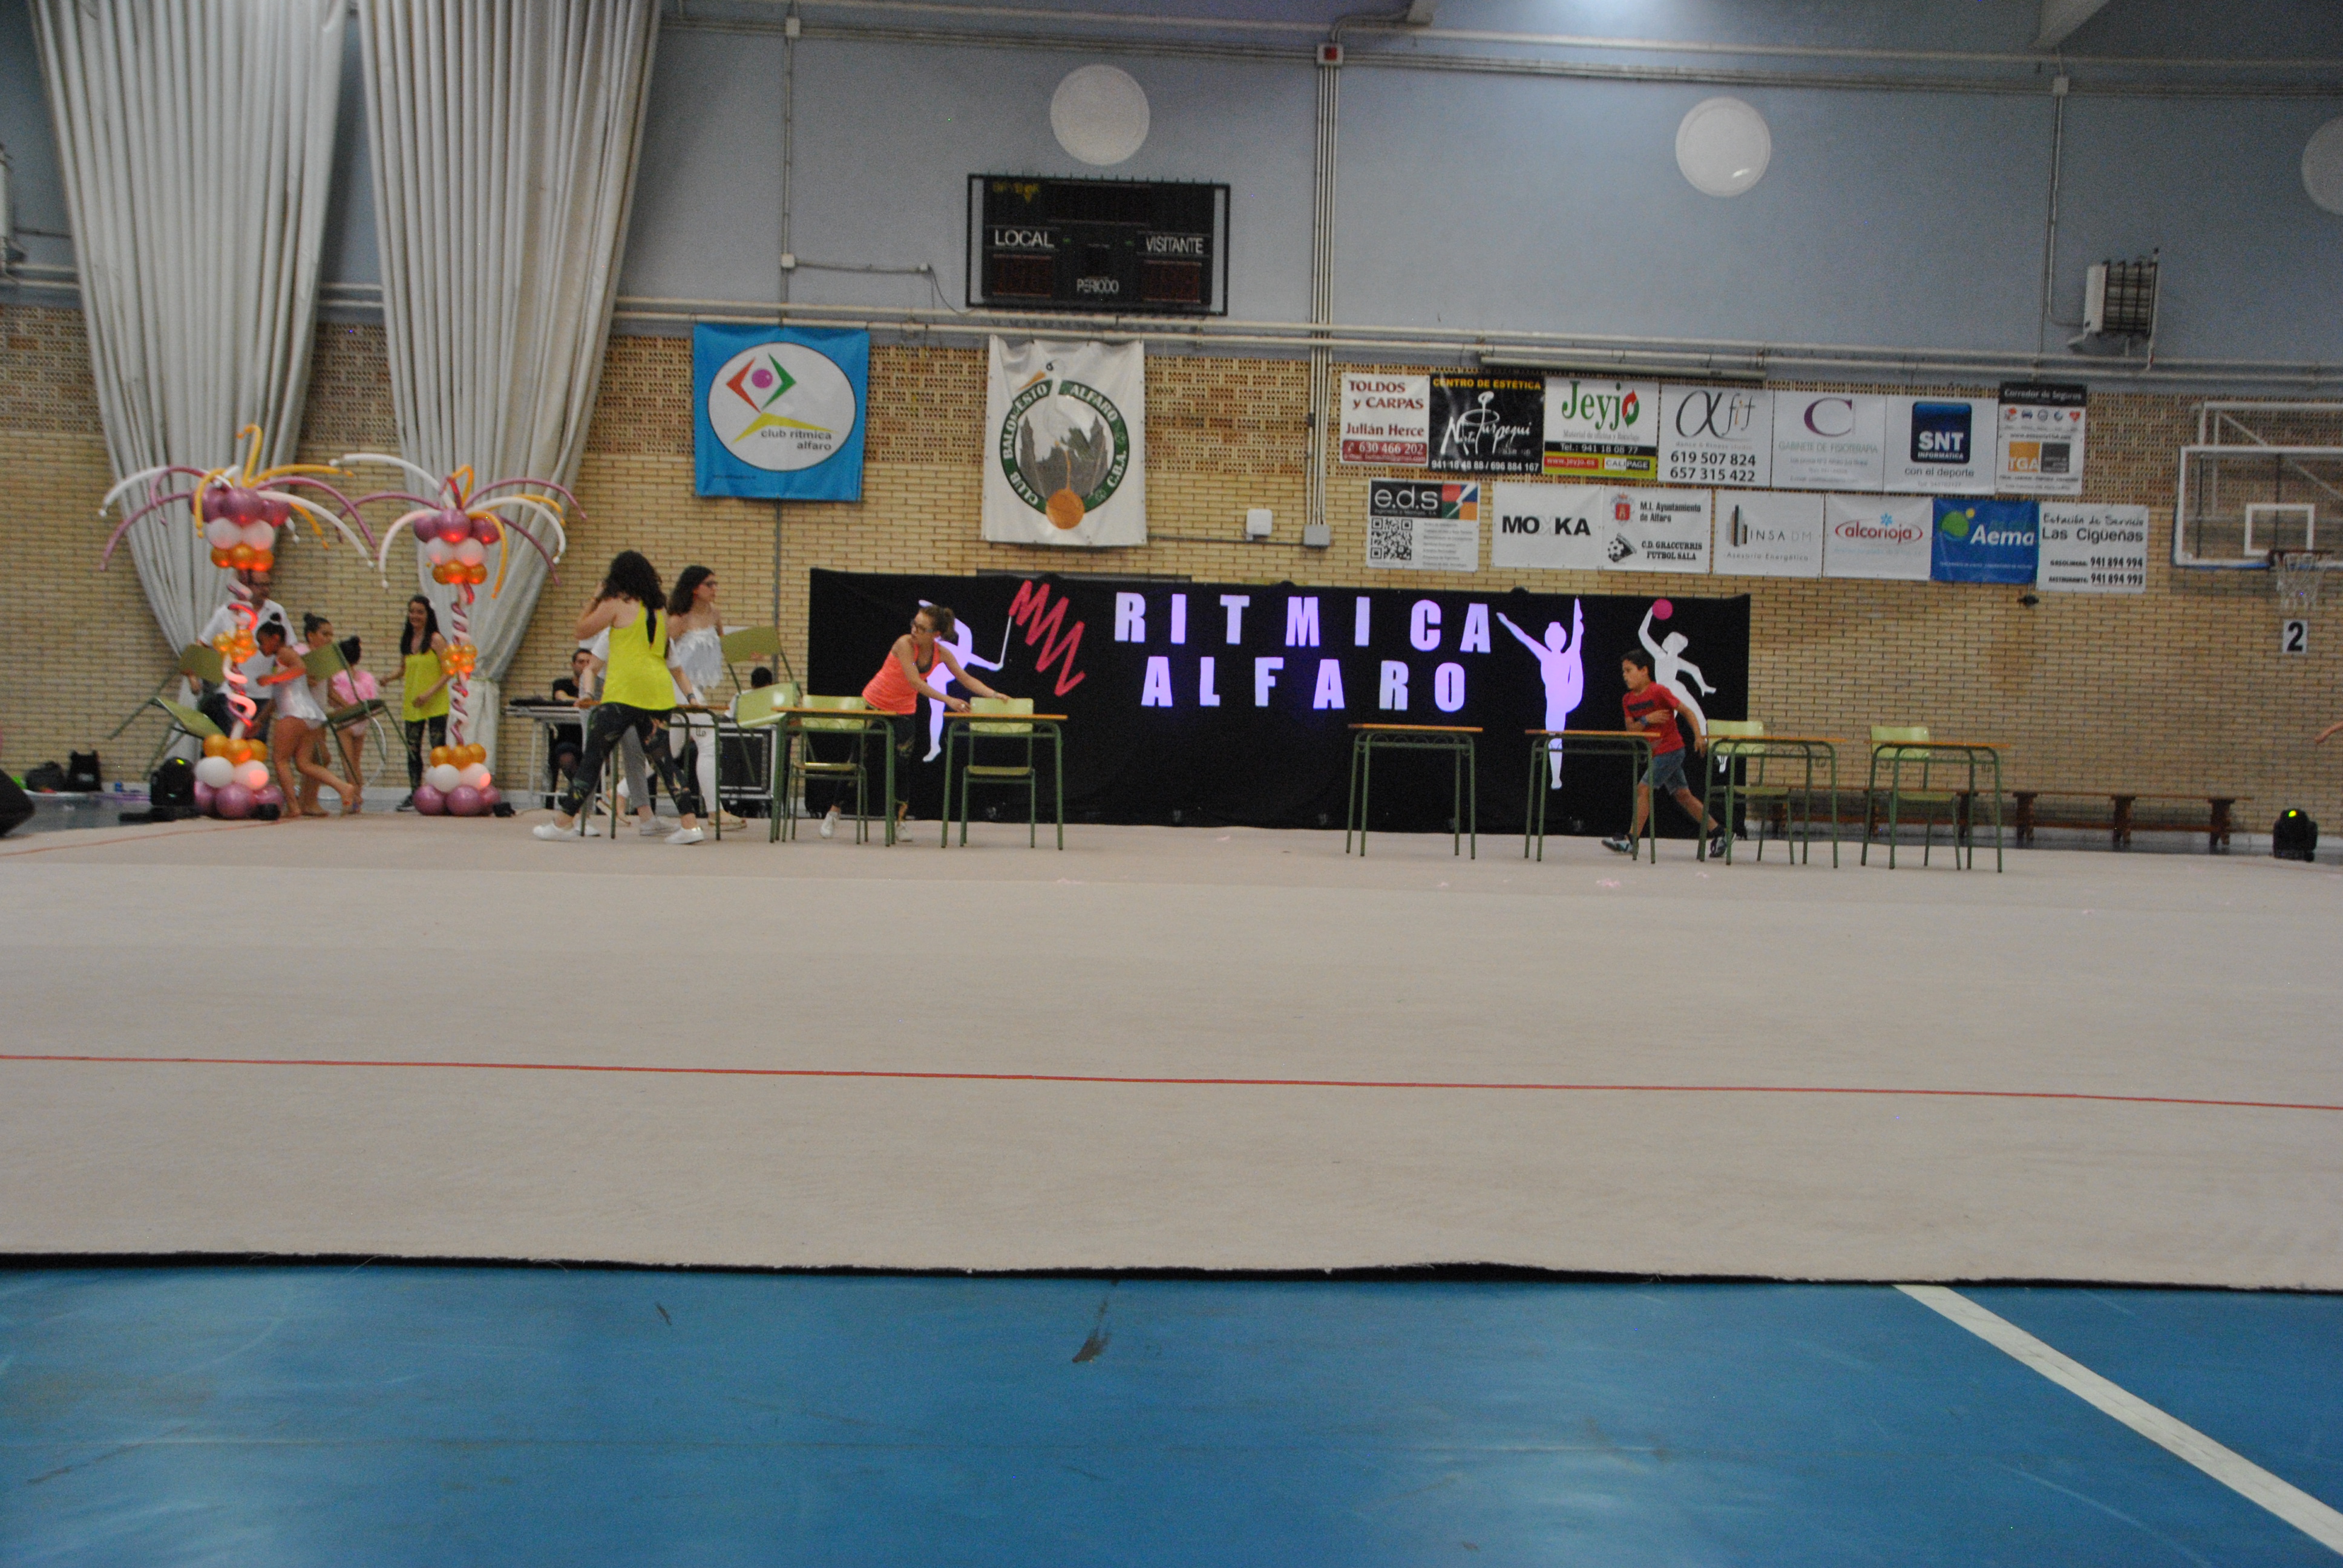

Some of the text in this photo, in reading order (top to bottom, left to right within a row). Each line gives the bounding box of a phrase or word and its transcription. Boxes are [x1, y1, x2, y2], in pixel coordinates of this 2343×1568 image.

[995, 229, 1054, 248] LOCAL
[1146, 237, 1204, 254] VISITANTE
[1077, 278, 1119, 294] PERIODO
[1349, 380, 1406, 393] TOLDOS
[1433, 378, 1474, 387] CENTRO
[1477, 379, 1490, 388] DE
[2004, 390, 2082, 401] Corredor de Seguros
[1070, 384, 1118, 422] ALFARO
[1352, 397, 1424, 410] y CARPAS
[1562, 381, 1639, 430] Jeyjo
[1804, 397, 1853, 438] C
[761, 429, 786, 438] club
[1346, 422, 1424, 437] Julián Herce
[797, 442, 832, 451] alfaro
[1359, 442, 1423, 454] 630 466 202
[1778, 441, 1878, 454] GABINETE DE FISIOTERAPIA
[1918, 431, 1964, 452] SNT
[1547, 457, 1595, 466] www.jeyjo.es
[1671, 451, 1756, 466] 619 507 824
[2008, 458, 2039, 470] TGA
[1432, 460, 1446, 469] 941
[1450, 460, 1459, 469] 18
[1461, 461, 1471, 469] 48
[1473, 461, 1484, 470] 88
[1490, 462, 1506, 470] 696
[1507, 462, 1522, 471] 884
[1670, 466, 1755, 482] 657 315 422
[1937, 468, 1974, 479] deporte
[1010, 471, 1039, 506] CLUB
[1374, 485, 1438, 510] e.d.s
[1656, 503, 1702, 512] Ayuntamiento
[1650, 514, 1672, 523] Alfaro
[2089, 515, 2101, 525] de
[2105, 515, 2145, 526] Servicio
[1750, 529, 1812, 543] INSA DM
[1970, 524, 2034, 546] Aema
[2042, 528, 2143, 544] Las Cigüeñas
[1656, 541, 1702, 550] GRACCURRIS
[1647, 552, 1676, 560] FUTBOL
[2090, 557, 2105, 567] 941
[2108, 557, 2124, 567] 894
[2126, 557, 2143, 568] 994
[2091, 573, 2106, 584] 941
[2108, 573, 2124, 584] 894
[1115, 592, 1491, 654] RITMICA
[2287, 621, 2304, 652] 2
[1141, 656, 1466, 713] ALFARO
